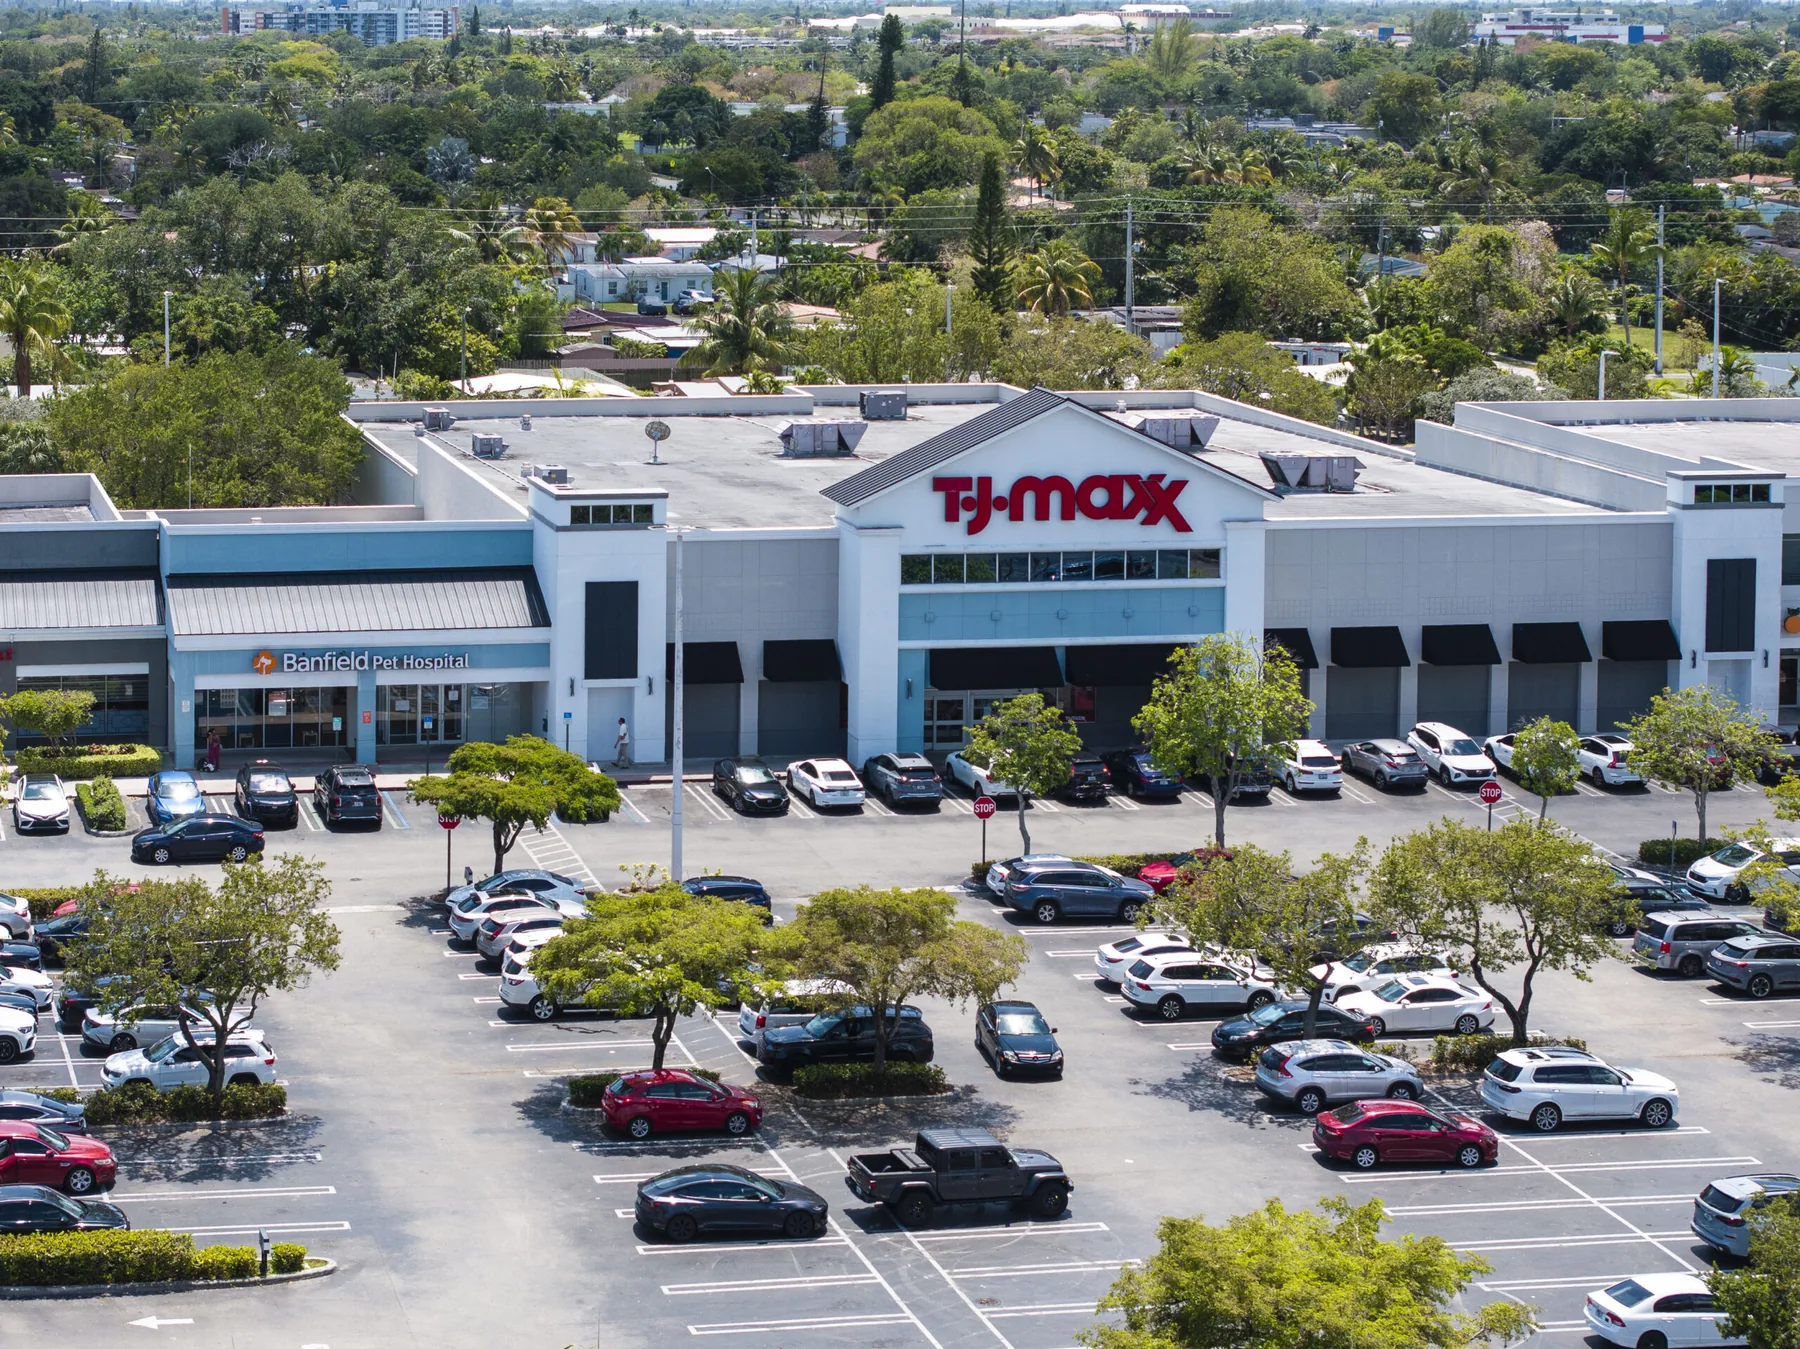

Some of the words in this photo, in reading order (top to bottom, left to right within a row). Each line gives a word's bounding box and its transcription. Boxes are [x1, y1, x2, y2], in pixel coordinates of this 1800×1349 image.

[283, 651, 369, 672] Banfield
[372, 655, 398, 670] Pet
[403, 653, 469, 672] Hospital
[1481, 788, 1501, 797] STOP
[975, 803, 995, 813] STOP
